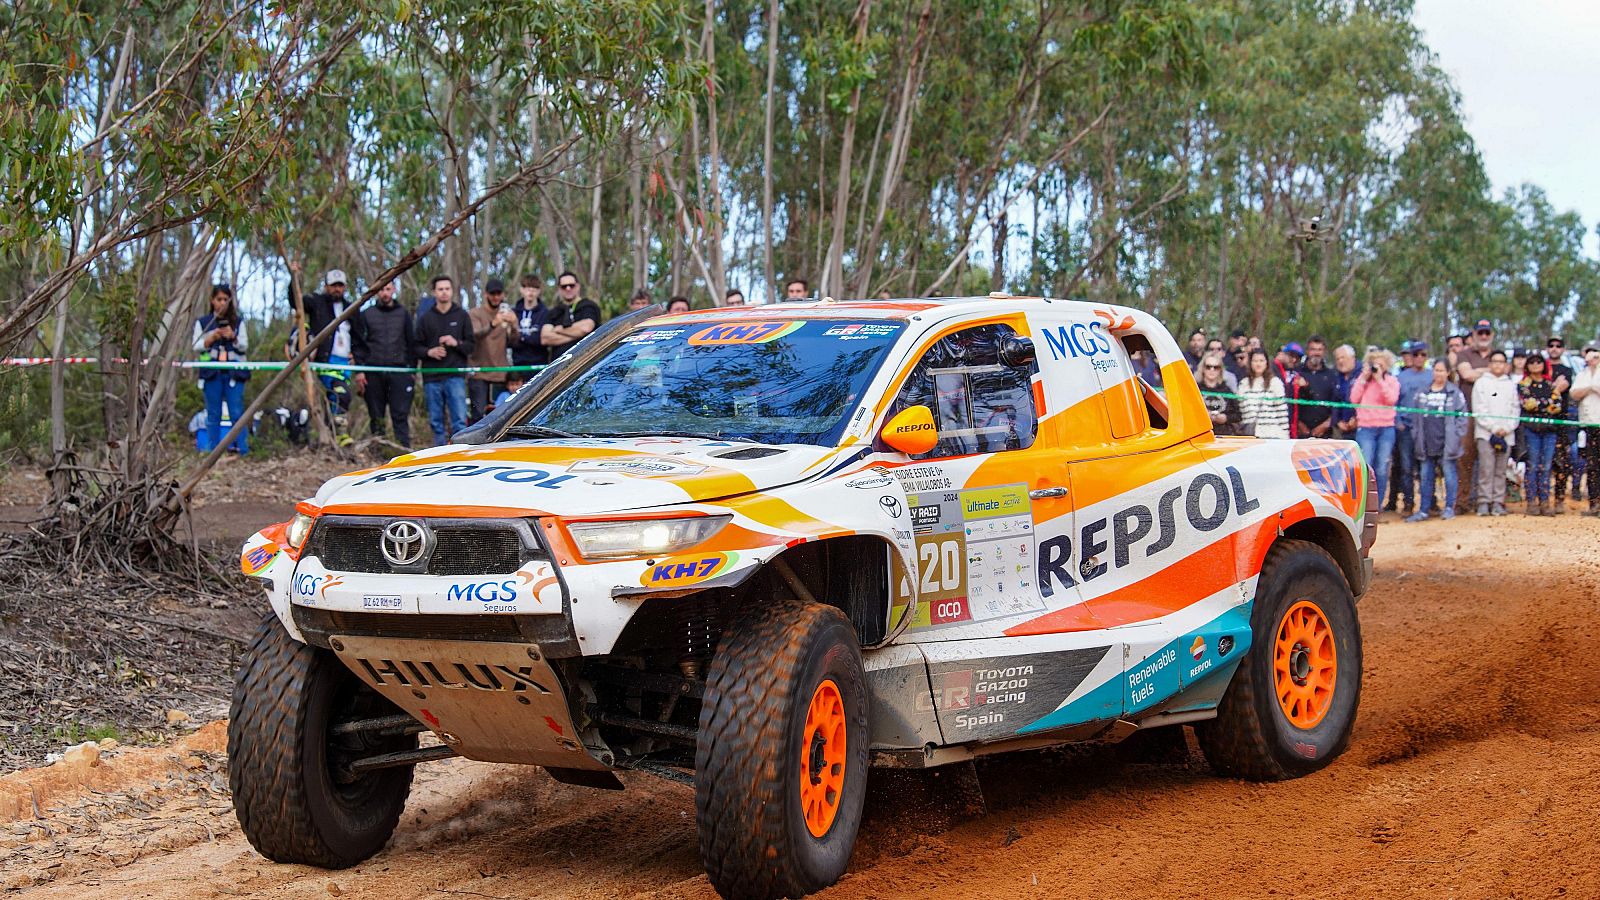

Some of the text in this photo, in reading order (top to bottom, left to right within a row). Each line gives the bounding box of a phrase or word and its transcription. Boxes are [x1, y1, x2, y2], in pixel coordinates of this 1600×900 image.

[1041, 321, 1111, 360] MGS
[896, 422, 935, 434] REPSOL
[352, 464, 578, 490] REPSOL
[914, 467, 936, 479] ESTEVE
[915, 479, 944, 491] VILLALOBOS
[944, 493, 958, 502] 2024
[967, 499, 1000, 513] ultimate
[918, 507, 938, 518] RAID
[1038, 466, 1261, 598] REPSOL
[293, 573, 322, 596] MGS
[447, 580, 518, 602] MGS
[484, 603, 518, 613] Seguros
[938, 602, 961, 618] acp
[356, 659, 552, 694] HILUX
[976, 665, 1034, 681] TOYOTA
[1129, 648, 1177, 689] Renewable
[1190, 659, 1213, 678] REPSOL
[975, 678, 1028, 693] GAZOO
[915, 686, 970, 711] GR
[975, 691, 1026, 704] Racing
[1131, 683, 1155, 706] fuels
[955, 711, 1004, 729] Spain
